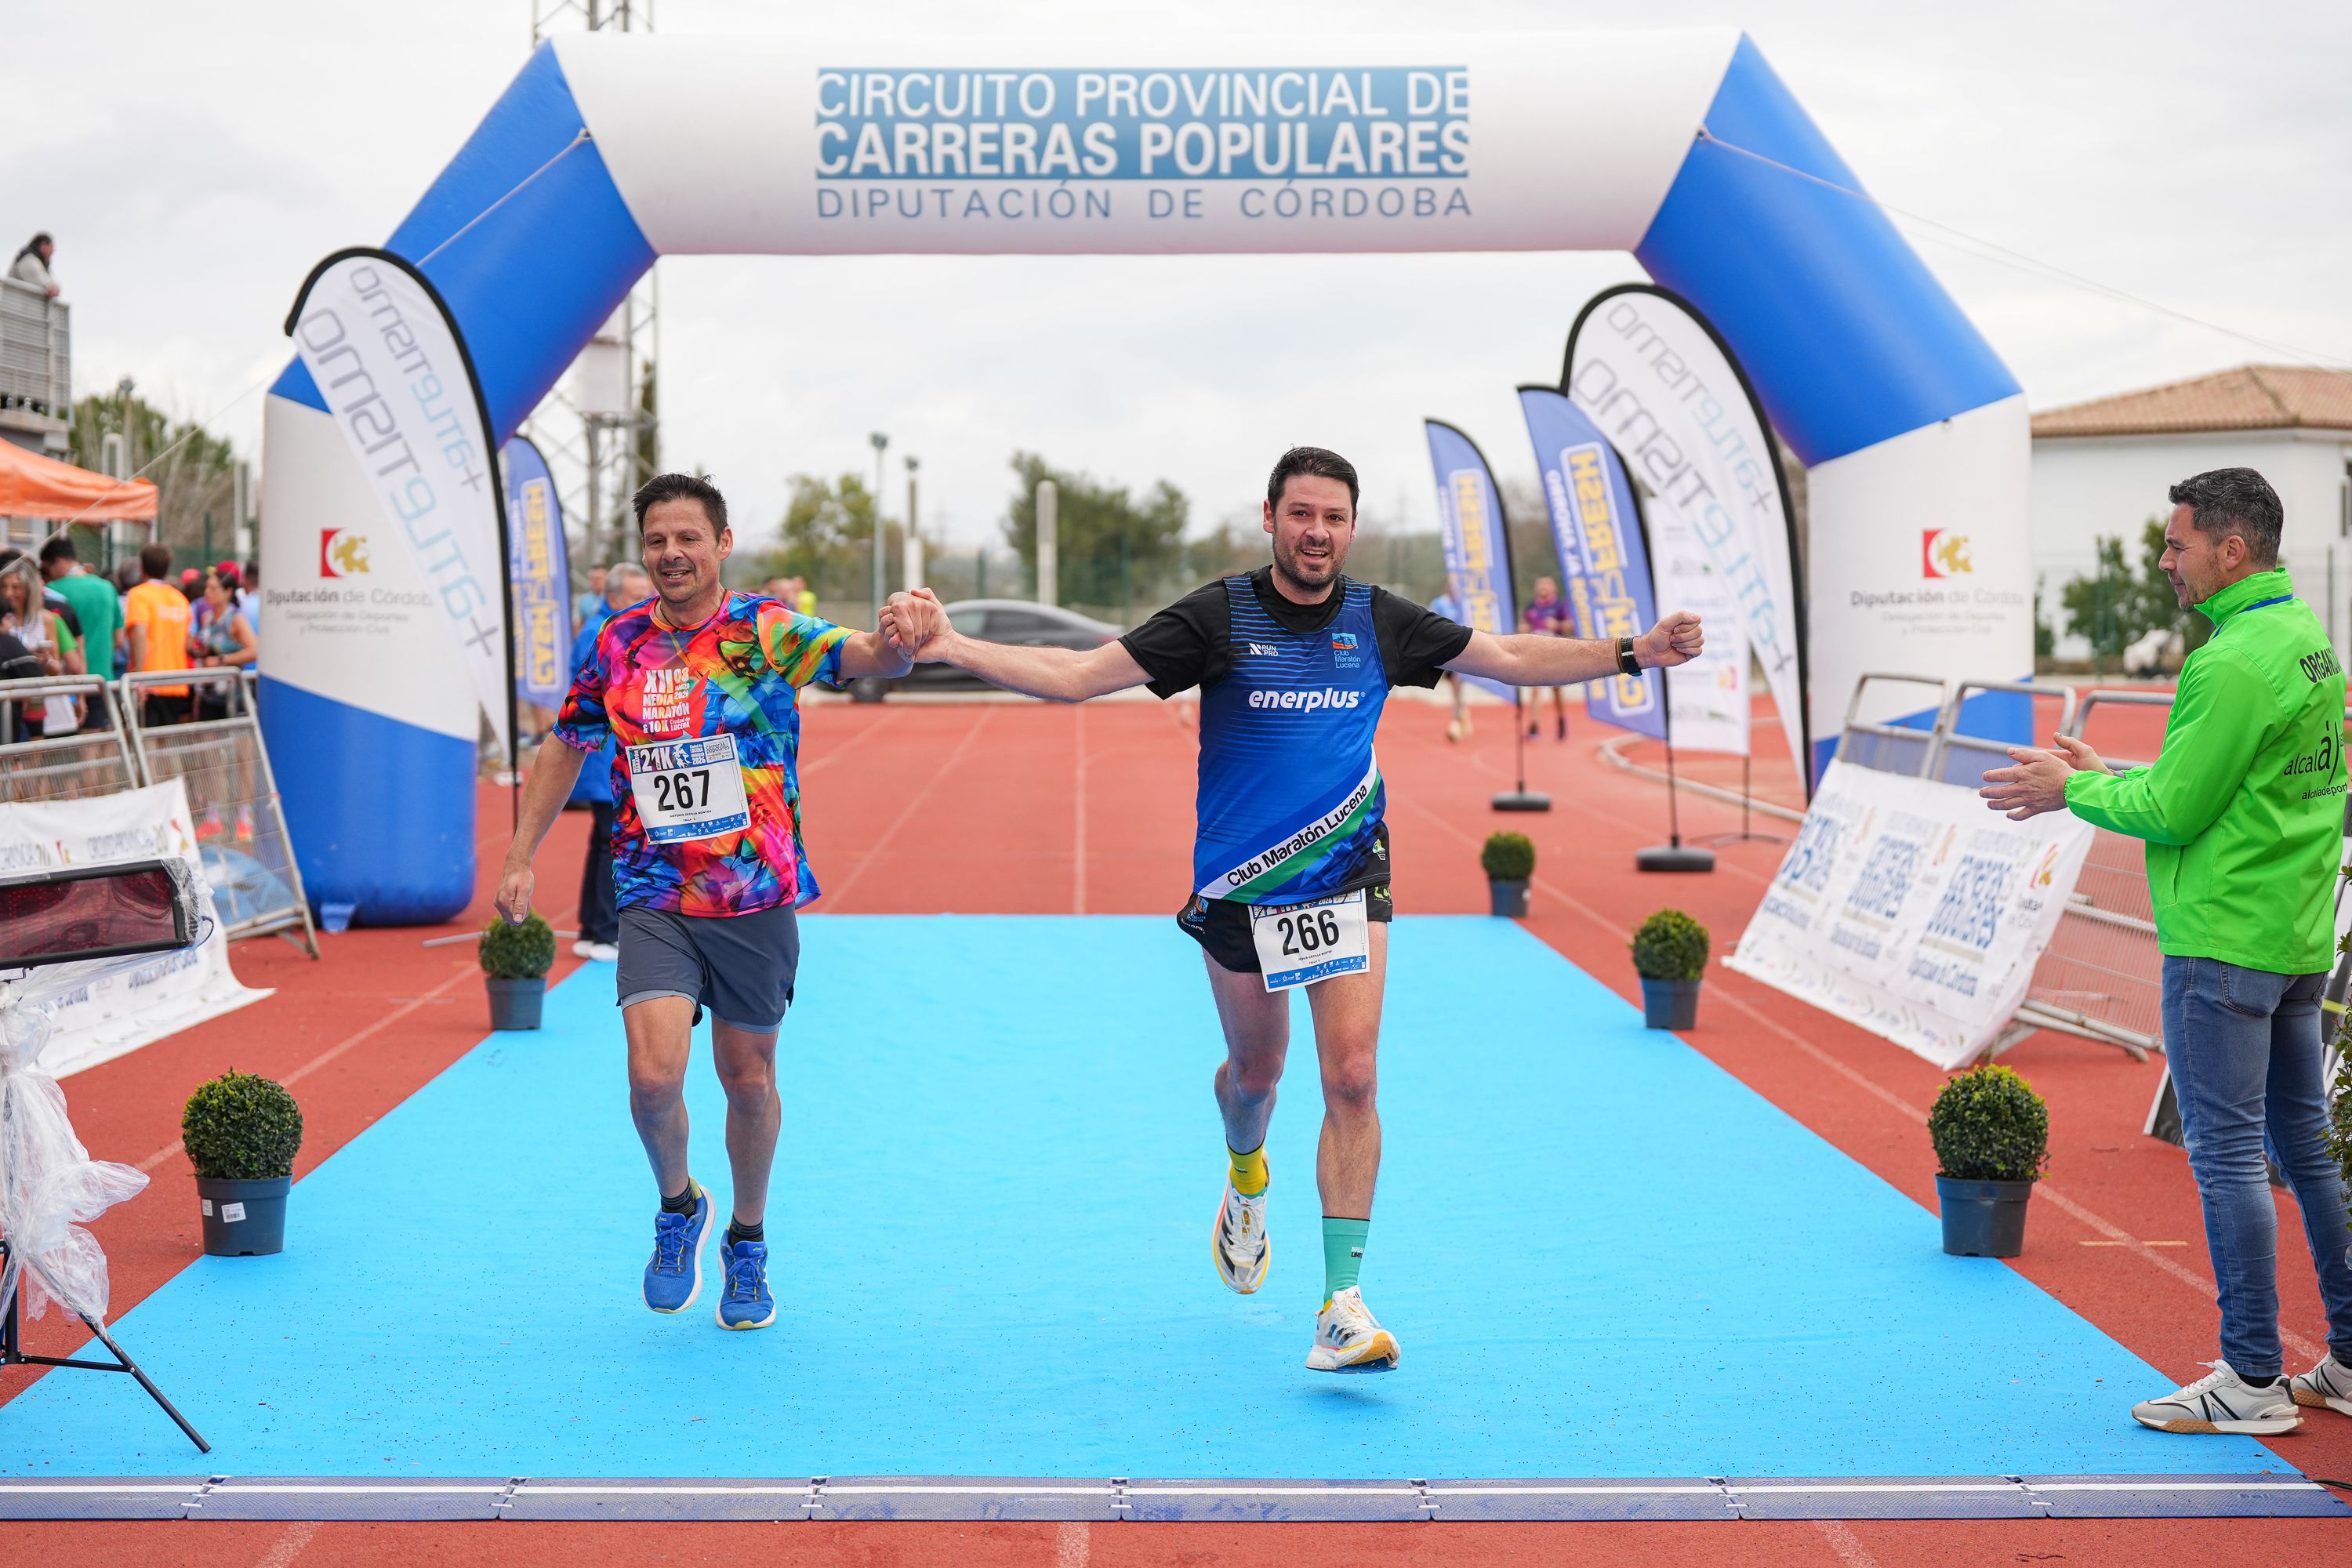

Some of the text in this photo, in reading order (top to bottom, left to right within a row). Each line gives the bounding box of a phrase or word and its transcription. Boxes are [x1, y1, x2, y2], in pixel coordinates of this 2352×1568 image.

[816, 71, 1468, 118] CIRCUITO PROVINCIAL DE
[816, 122, 1470, 176] CARRERAS POPULARES
[818, 180, 1472, 219] DIPUTACIÓN DE CÓRDOBA
[343, 587, 366, 603] de
[371, 586, 434, 605] Córdob
[1850, 586, 1945, 608] Diputación
[1948, 588, 1970, 604] de
[643, 669, 673, 694] XII
[674, 667, 689, 684] 08
[643, 693, 674, 706] MEDIA
[643, 701, 690, 720] MARATÓN
[1248, 688, 1360, 713] enerplus
[649, 719, 669, 733] 10K
[670, 721, 690, 731] LUCENA
[640, 746, 674, 772] 21K
[692, 757, 706, 765] 2026
[654, 769, 710, 811] 267
[1227, 784, 1368, 887] Club Maratón Lucena
[1277, 909, 1340, 956] 266
